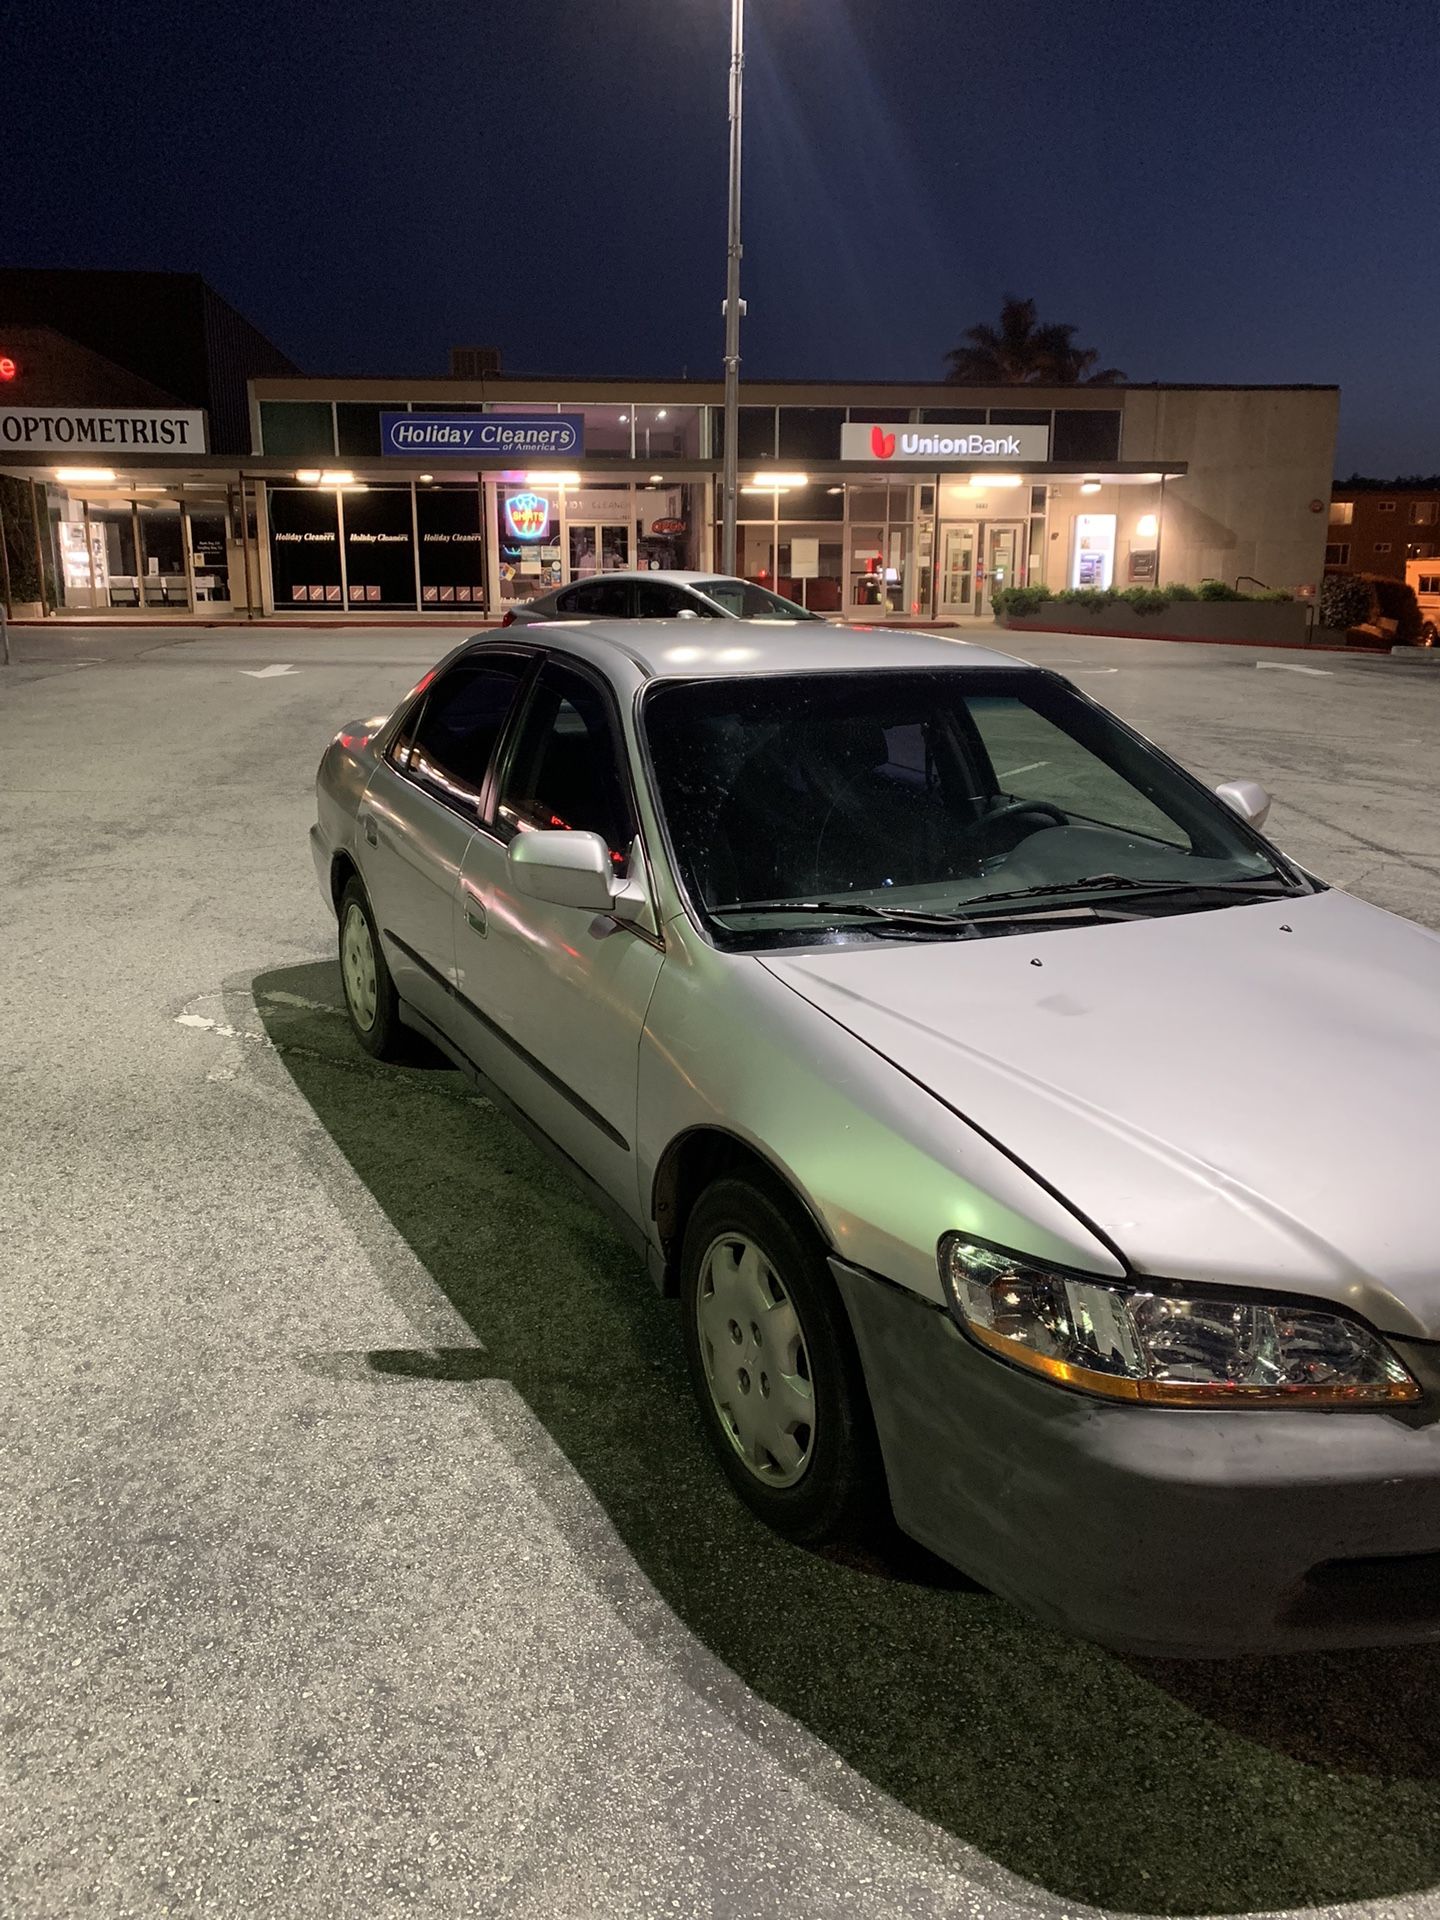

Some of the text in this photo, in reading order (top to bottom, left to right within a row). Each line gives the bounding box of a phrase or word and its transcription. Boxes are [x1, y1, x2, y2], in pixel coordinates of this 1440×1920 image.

[2, 415, 190, 445] OPTOMETRIST
[398, 425, 571, 445] Holiday Cleaners
[502, 443, 556, 451] of America
[902, 434, 1020, 455] UnionBank
[275, 533, 335, 543] Holiday Cleaners
[349, 533, 377, 543] Holiday
[424, 533, 481, 543] Holiday Cleaners
